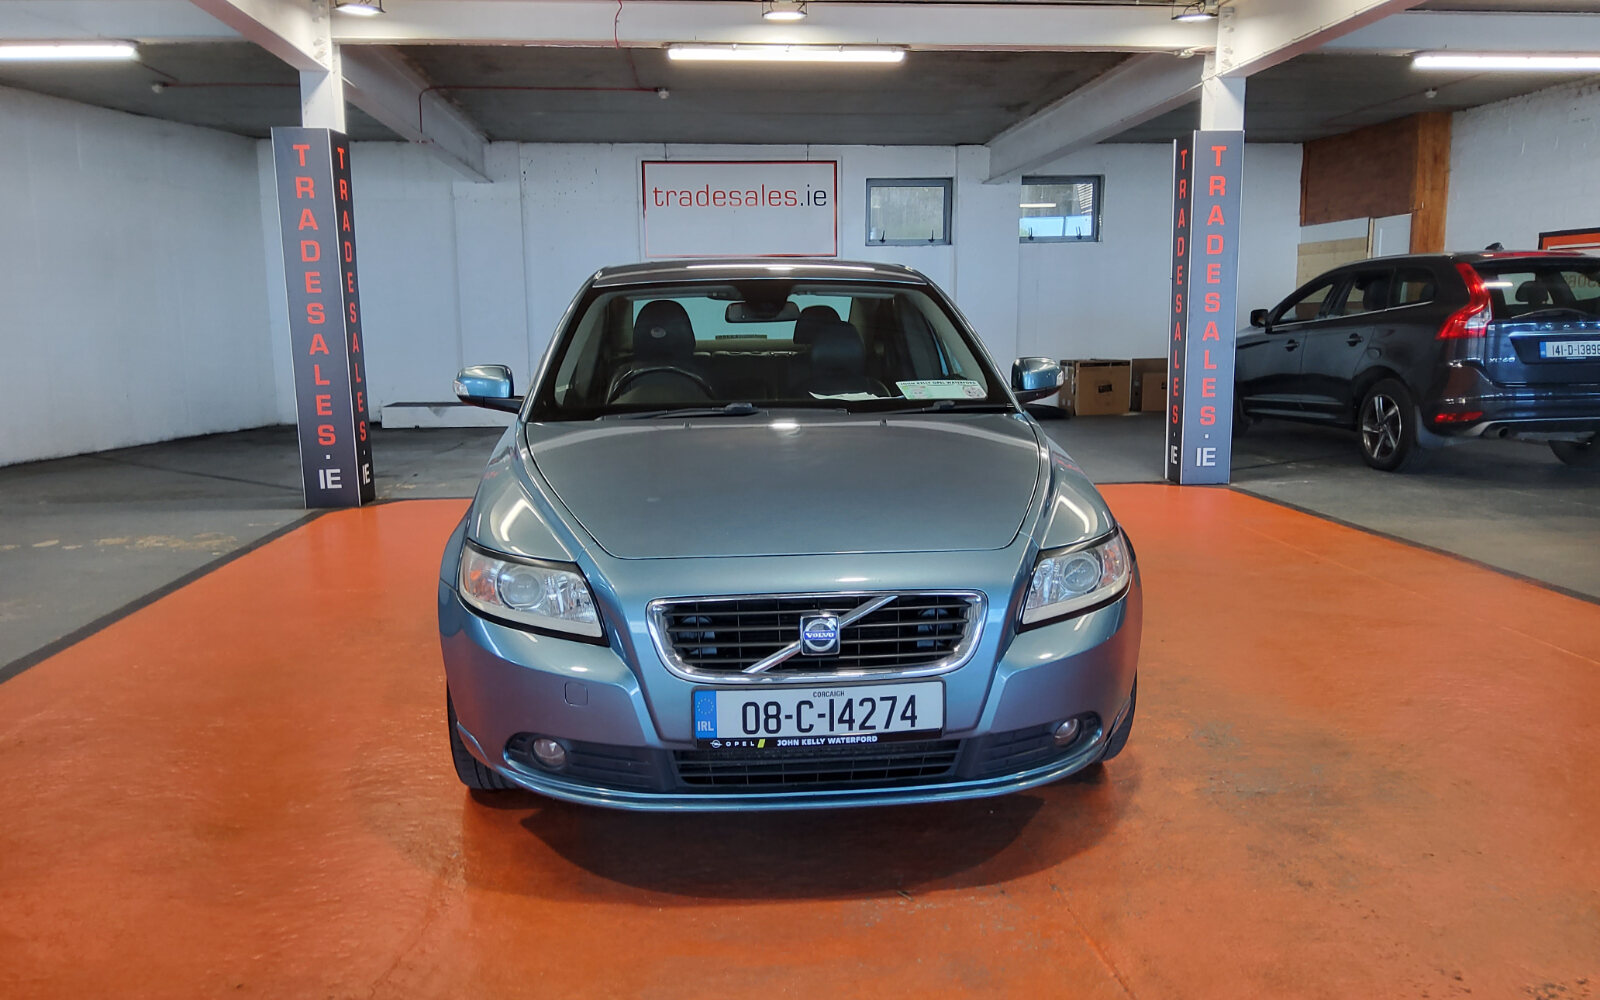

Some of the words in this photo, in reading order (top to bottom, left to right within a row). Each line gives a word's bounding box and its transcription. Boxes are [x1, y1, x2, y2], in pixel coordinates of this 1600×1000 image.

[652, 184, 827, 207] tradesales.ie
[812, 690, 845, 698] CORCAIGH
[741, 694, 918, 735] 08-C-14274
[697, 720, 715, 732] IRL
[777, 739, 800, 747] JOHN
[801, 737, 826, 746] KELLY
[827, 735, 878, 745] WATERFORD
